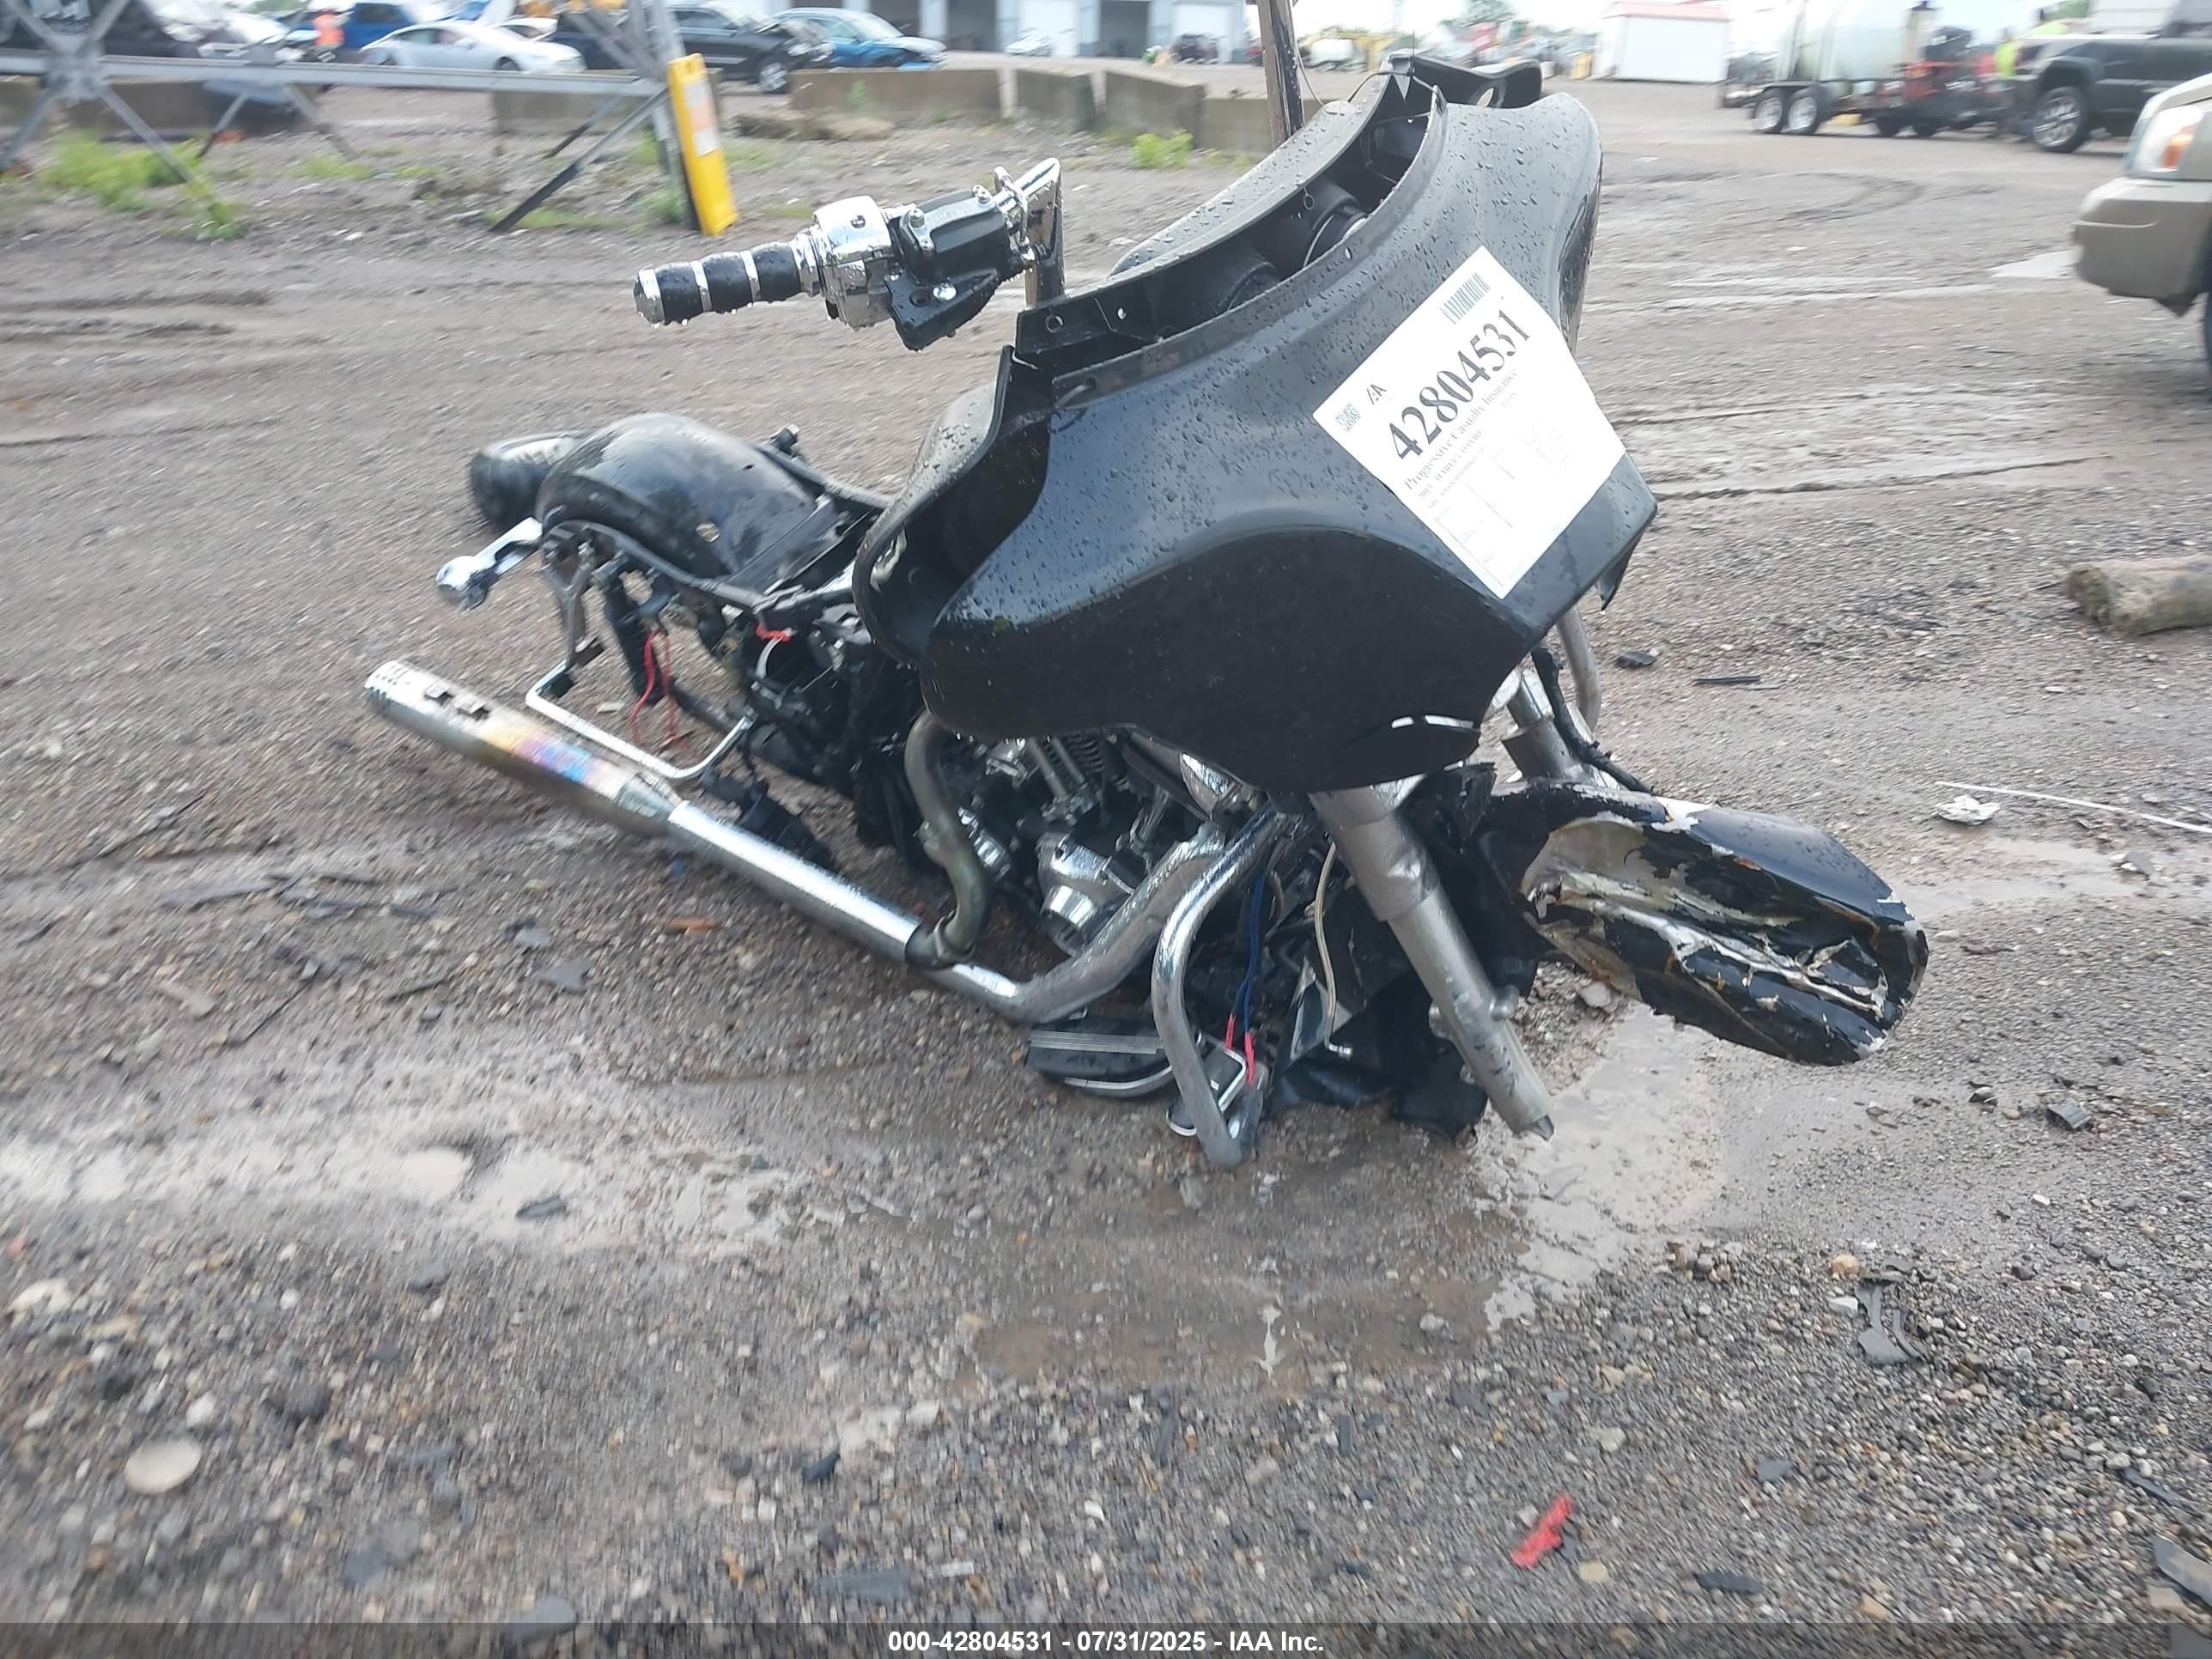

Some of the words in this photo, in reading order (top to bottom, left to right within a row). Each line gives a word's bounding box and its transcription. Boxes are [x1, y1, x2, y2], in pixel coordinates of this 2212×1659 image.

[1389, 308, 1531, 460] 42804531
[1402, 439, 1453, 489] Progressive
[1449, 401, 1485, 441] Casualty
[1480, 368, 1518, 405] Insurance
